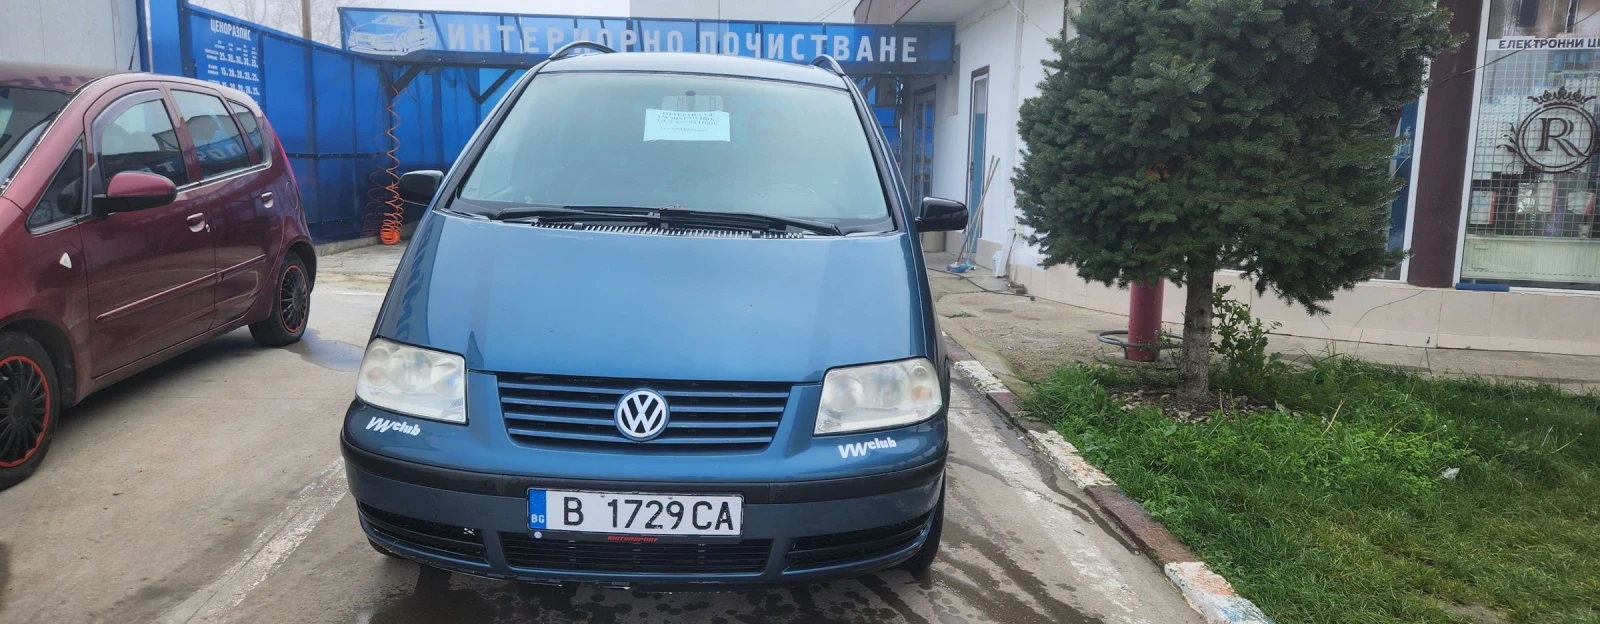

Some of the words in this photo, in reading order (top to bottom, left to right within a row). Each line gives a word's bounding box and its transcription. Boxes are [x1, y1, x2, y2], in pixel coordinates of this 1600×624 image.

[210, 18, 251, 41] ЦЕНОРАЗПИС
[447, 23, 684, 54] ИНТЕРИОРНО
[699, 31, 919, 63] ПОЧИСТВАНЕ
[1498, 38, 1584, 49] ЕЛЕКТРОННИ
[531, 514, 545, 524] BG
[563, 496, 584, 526] B
[607, 499, 685, 530] 1729
[607, 535, 659, 543] MOTORSPORT
